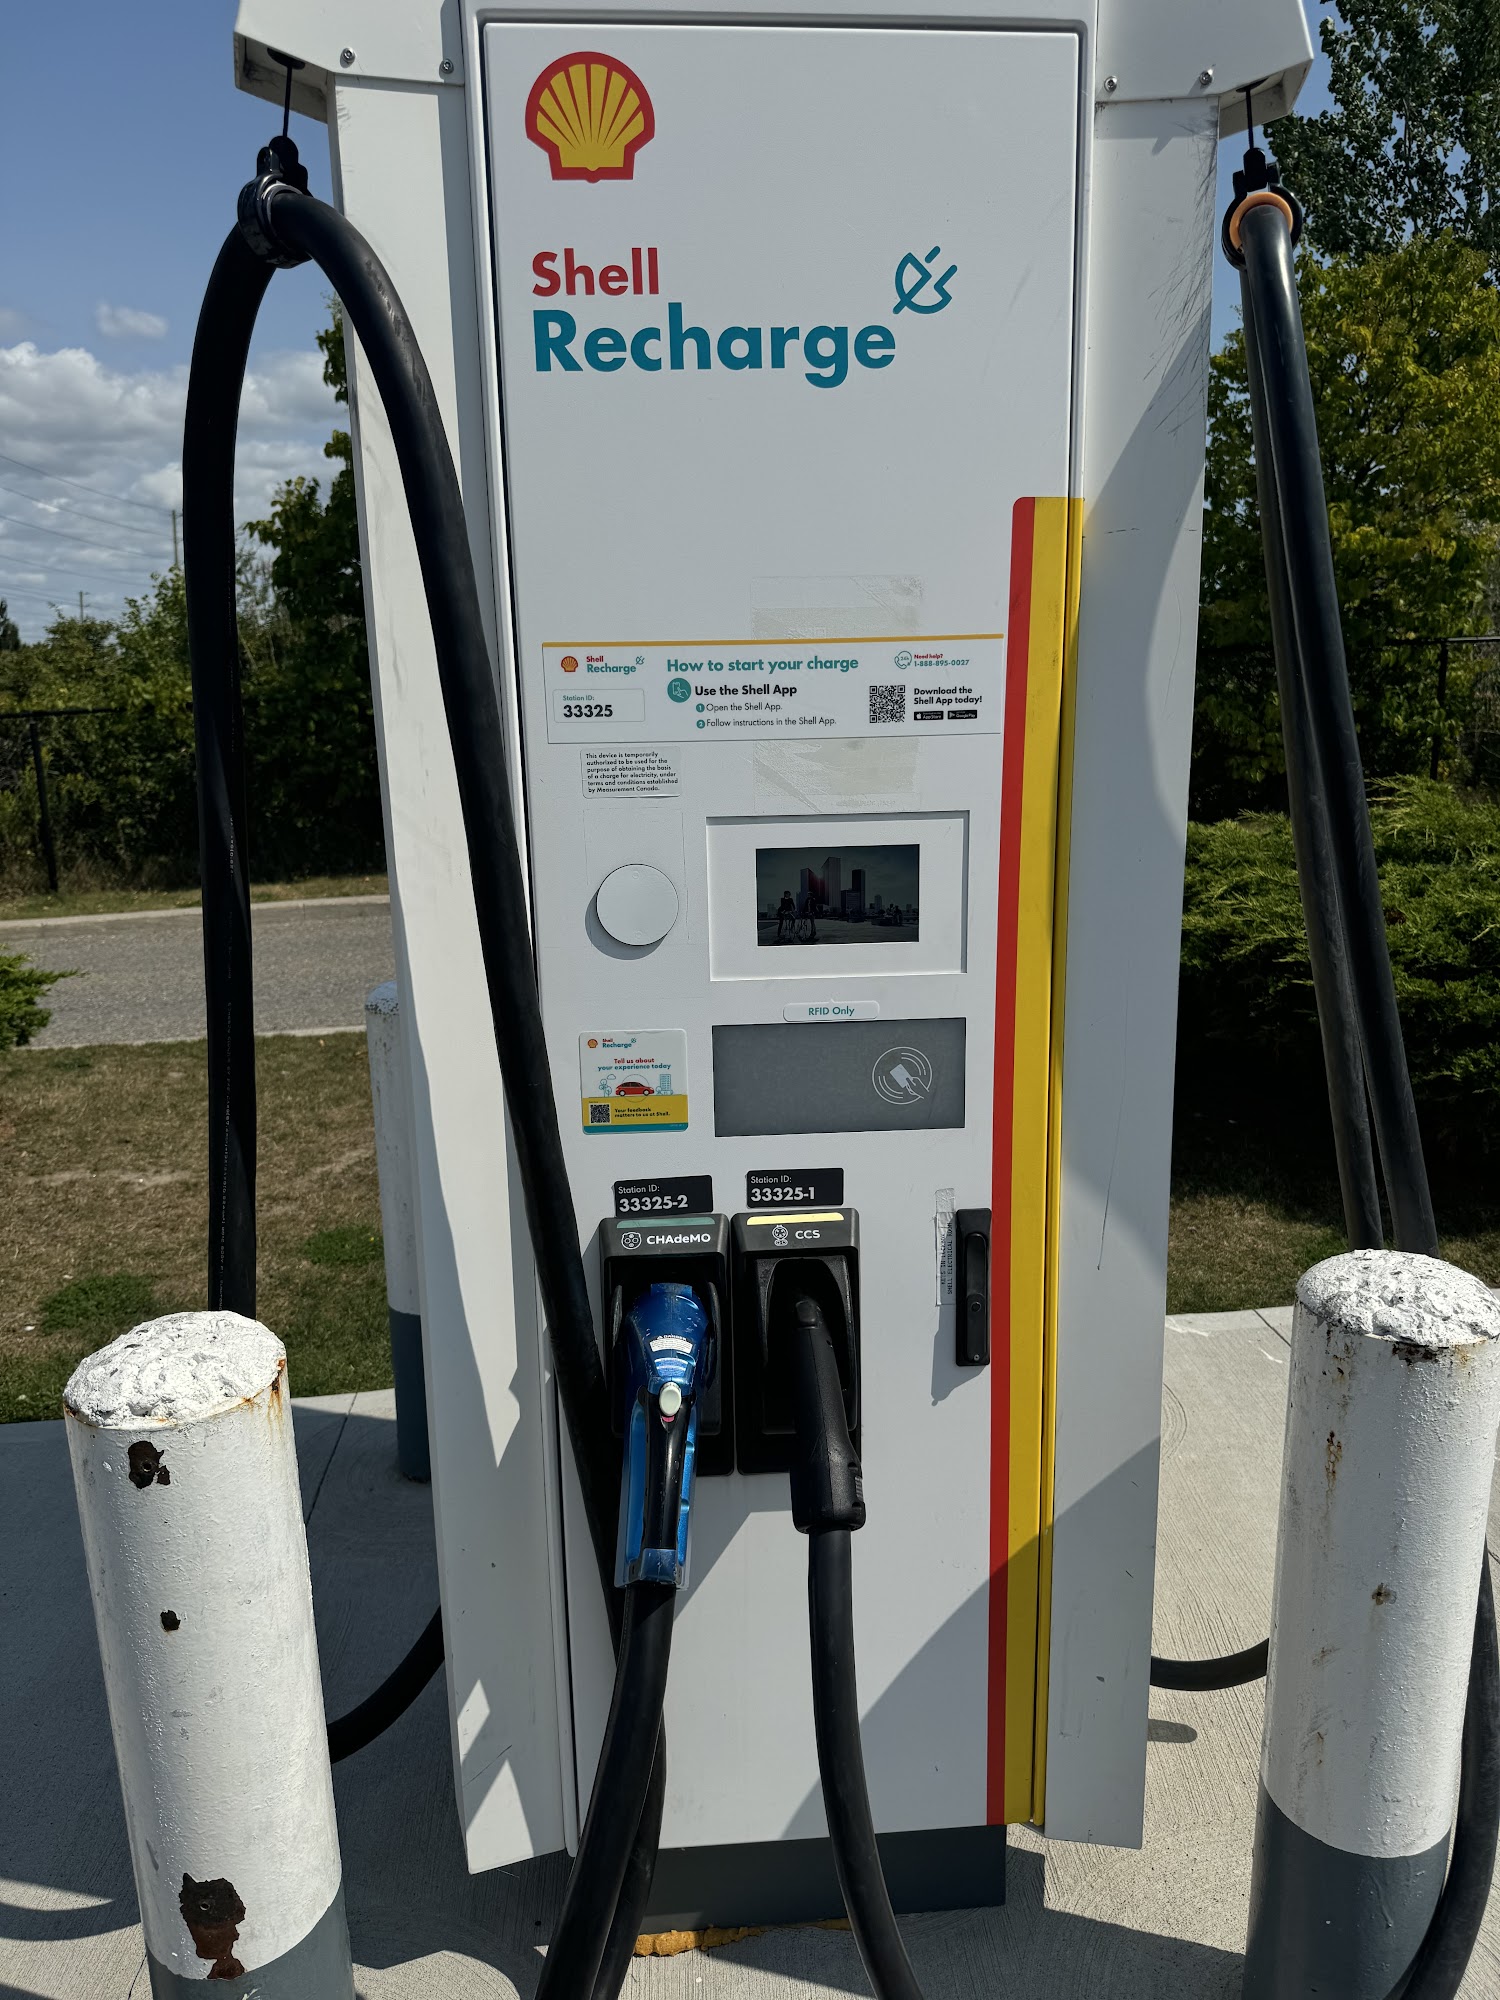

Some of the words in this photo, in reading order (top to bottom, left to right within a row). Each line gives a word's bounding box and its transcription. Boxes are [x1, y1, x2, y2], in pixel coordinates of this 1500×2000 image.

[532, 247, 660, 296] Shell
[532, 302, 897, 388] Recharge
[586, 663, 637, 675] Recharge
[667, 659, 704, 672] How
[708, 659, 724, 672] to
[728, 658, 764, 672] start
[768, 660, 803, 675] your
[807, 656, 859, 673] charge
[694, 685, 717, 696] Use
[719, 685, 739, 696] the
[742, 684, 770, 696] Shell
[773, 685, 797, 698] App
[914, 687, 957, 696] Download
[959, 686, 973, 694] the
[562, 694, 584, 702] Station
[914, 696, 934, 704] Shell
[936, 696, 953, 706] App
[955, 695, 983, 705] today!
[563, 704, 613, 718] 33325
[706, 703, 728, 713] Open
[730, 702, 743, 711] the
[744, 702, 763, 711] Shell
[765, 703, 783, 714] App.
[706, 718, 731, 727] Follow
[733, 718, 774, 727] instructions
[776, 718, 783, 726] in
[784, 717, 797, 726] the
[798, 717, 817, 725] Shell
[818, 717, 837, 728] App.
[808, 1007, 829, 1016] RFID
[832, 1005, 855, 1016] Only
[750, 1175, 778, 1184] Station
[780, 1175, 792, 1183] ID:
[618, 1186, 646, 1194] Station
[648, 1185, 660, 1193] ID:
[751, 1186, 815, 1202] 33325-1
[619, 1195, 688, 1212] 33325-2
[646, 1233, 711, 1245] CHAdeMO
[795, 1229, 821, 1240] CCS
